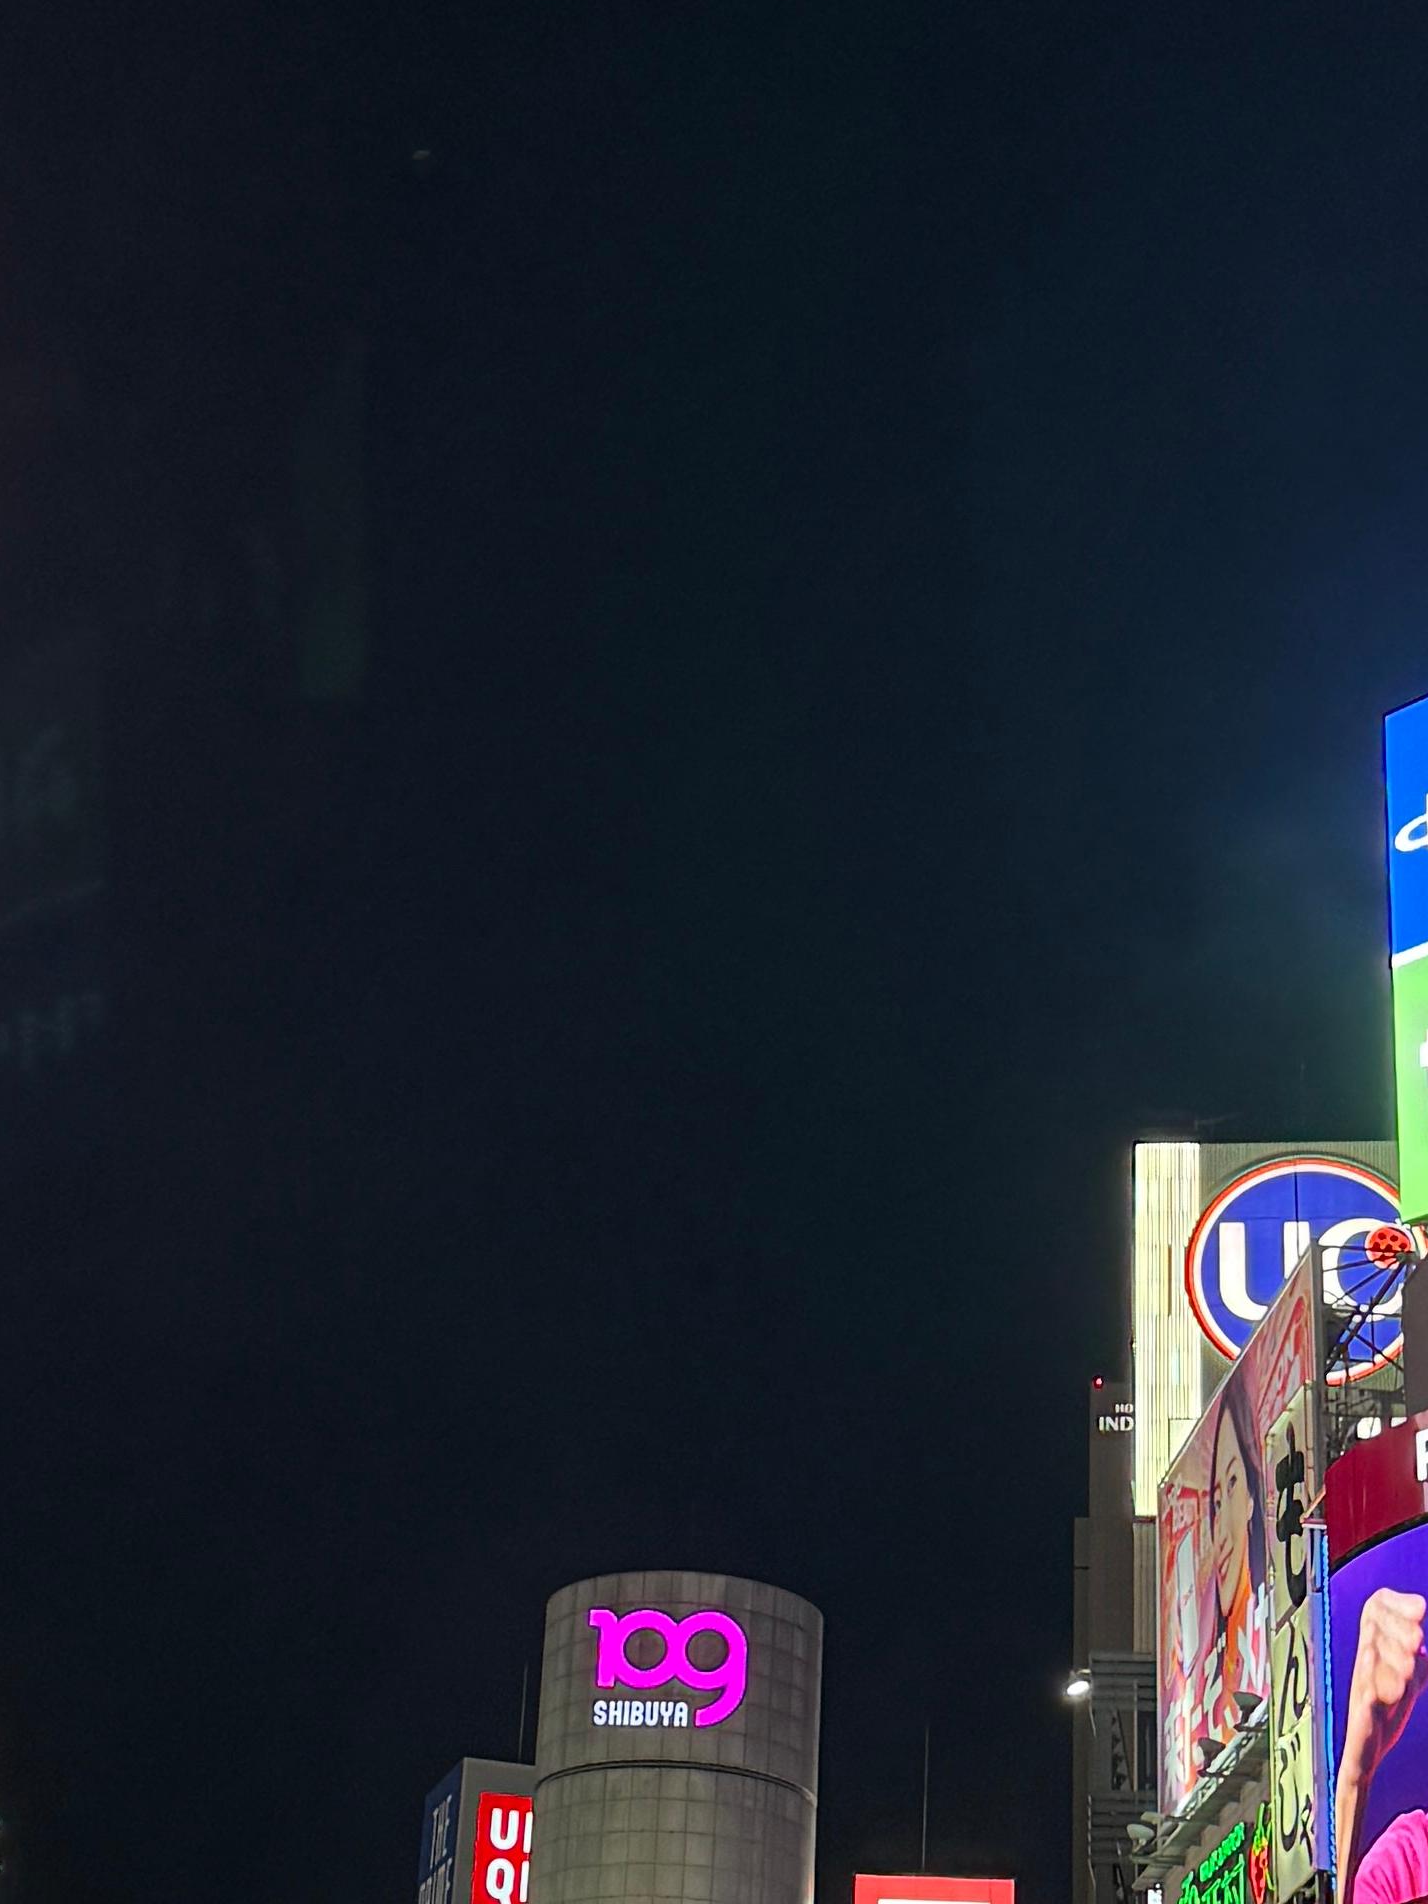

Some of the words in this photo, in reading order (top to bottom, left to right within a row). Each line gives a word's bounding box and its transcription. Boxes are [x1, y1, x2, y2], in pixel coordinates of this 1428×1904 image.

[1218, 1218, 1423, 1323] UC
[1098, 1415, 1134, 1432] IND
[587, 1607, 748, 1728] 109
[592, 1701, 689, 1728] SHIBUYA
